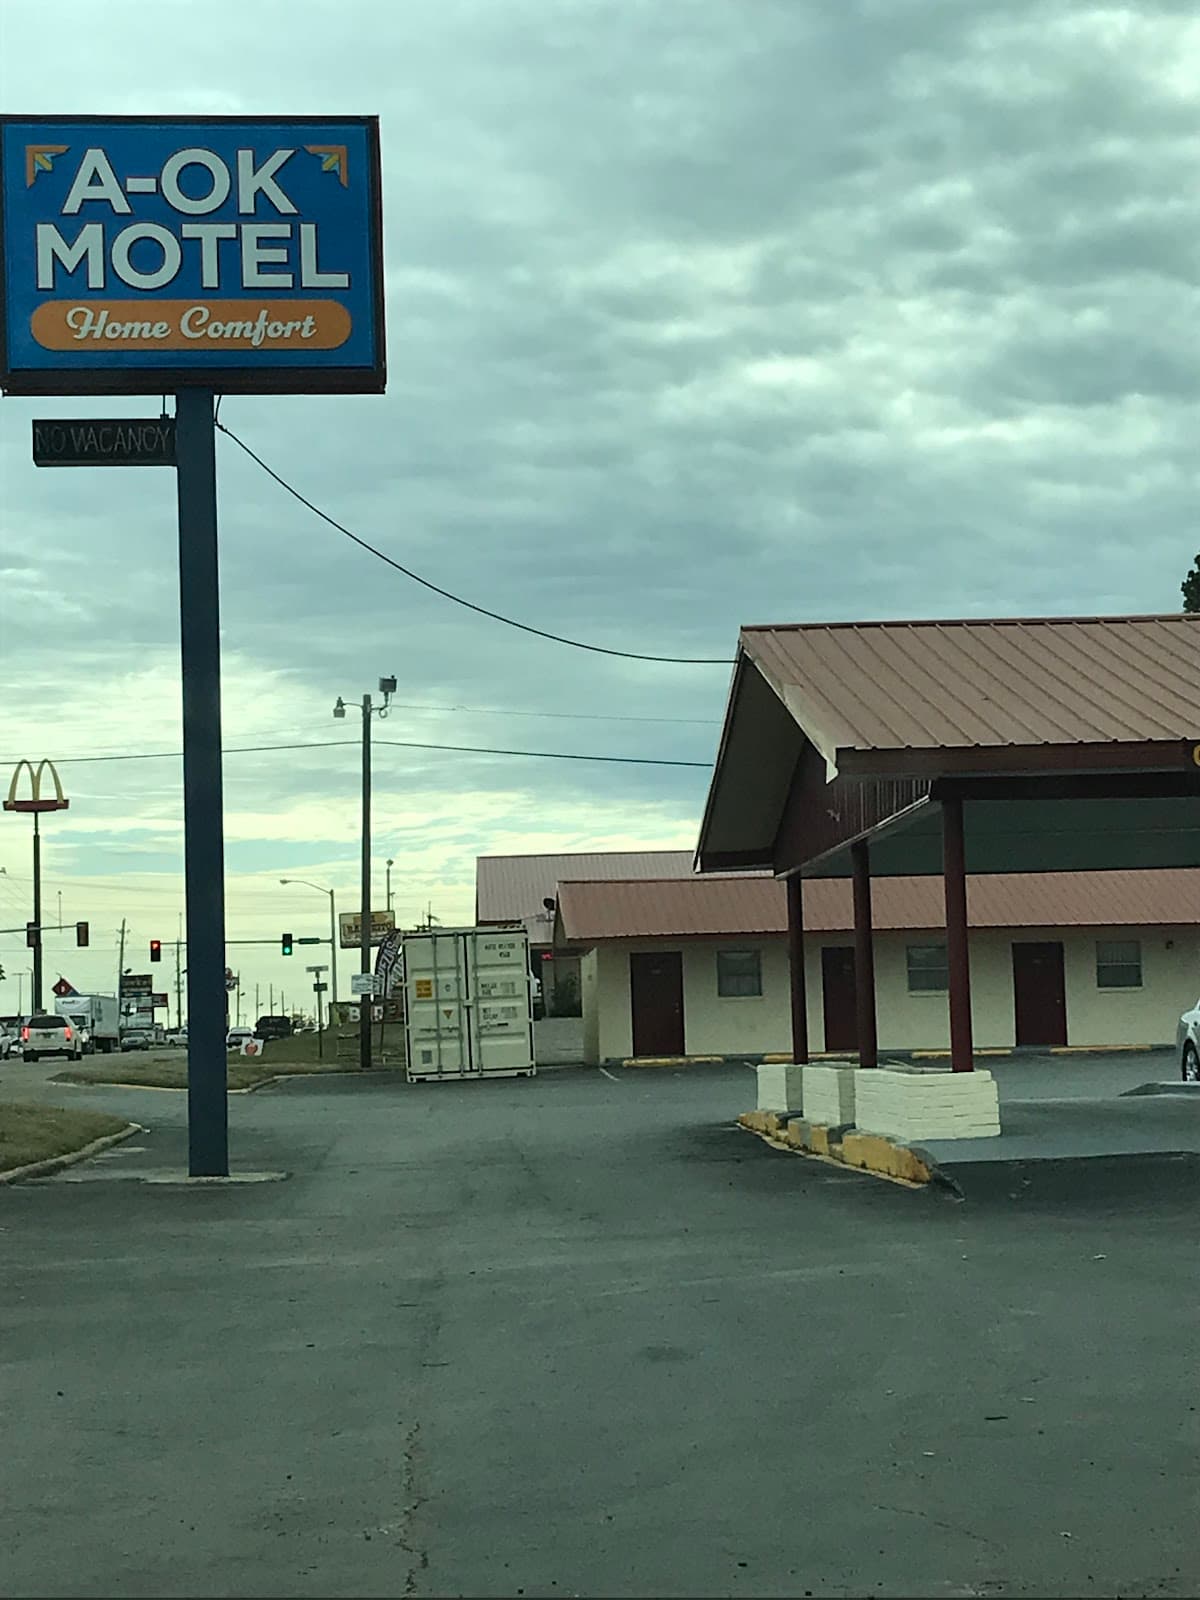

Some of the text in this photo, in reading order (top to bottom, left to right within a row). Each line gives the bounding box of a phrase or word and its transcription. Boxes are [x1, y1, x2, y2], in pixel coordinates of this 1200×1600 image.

[61, 148, 299, 215] A-OK
[36, 222, 350, 290] MOTEL
[66, 305, 317, 348] Home Comfort
[34, 426, 171, 453] NO VACANCY
